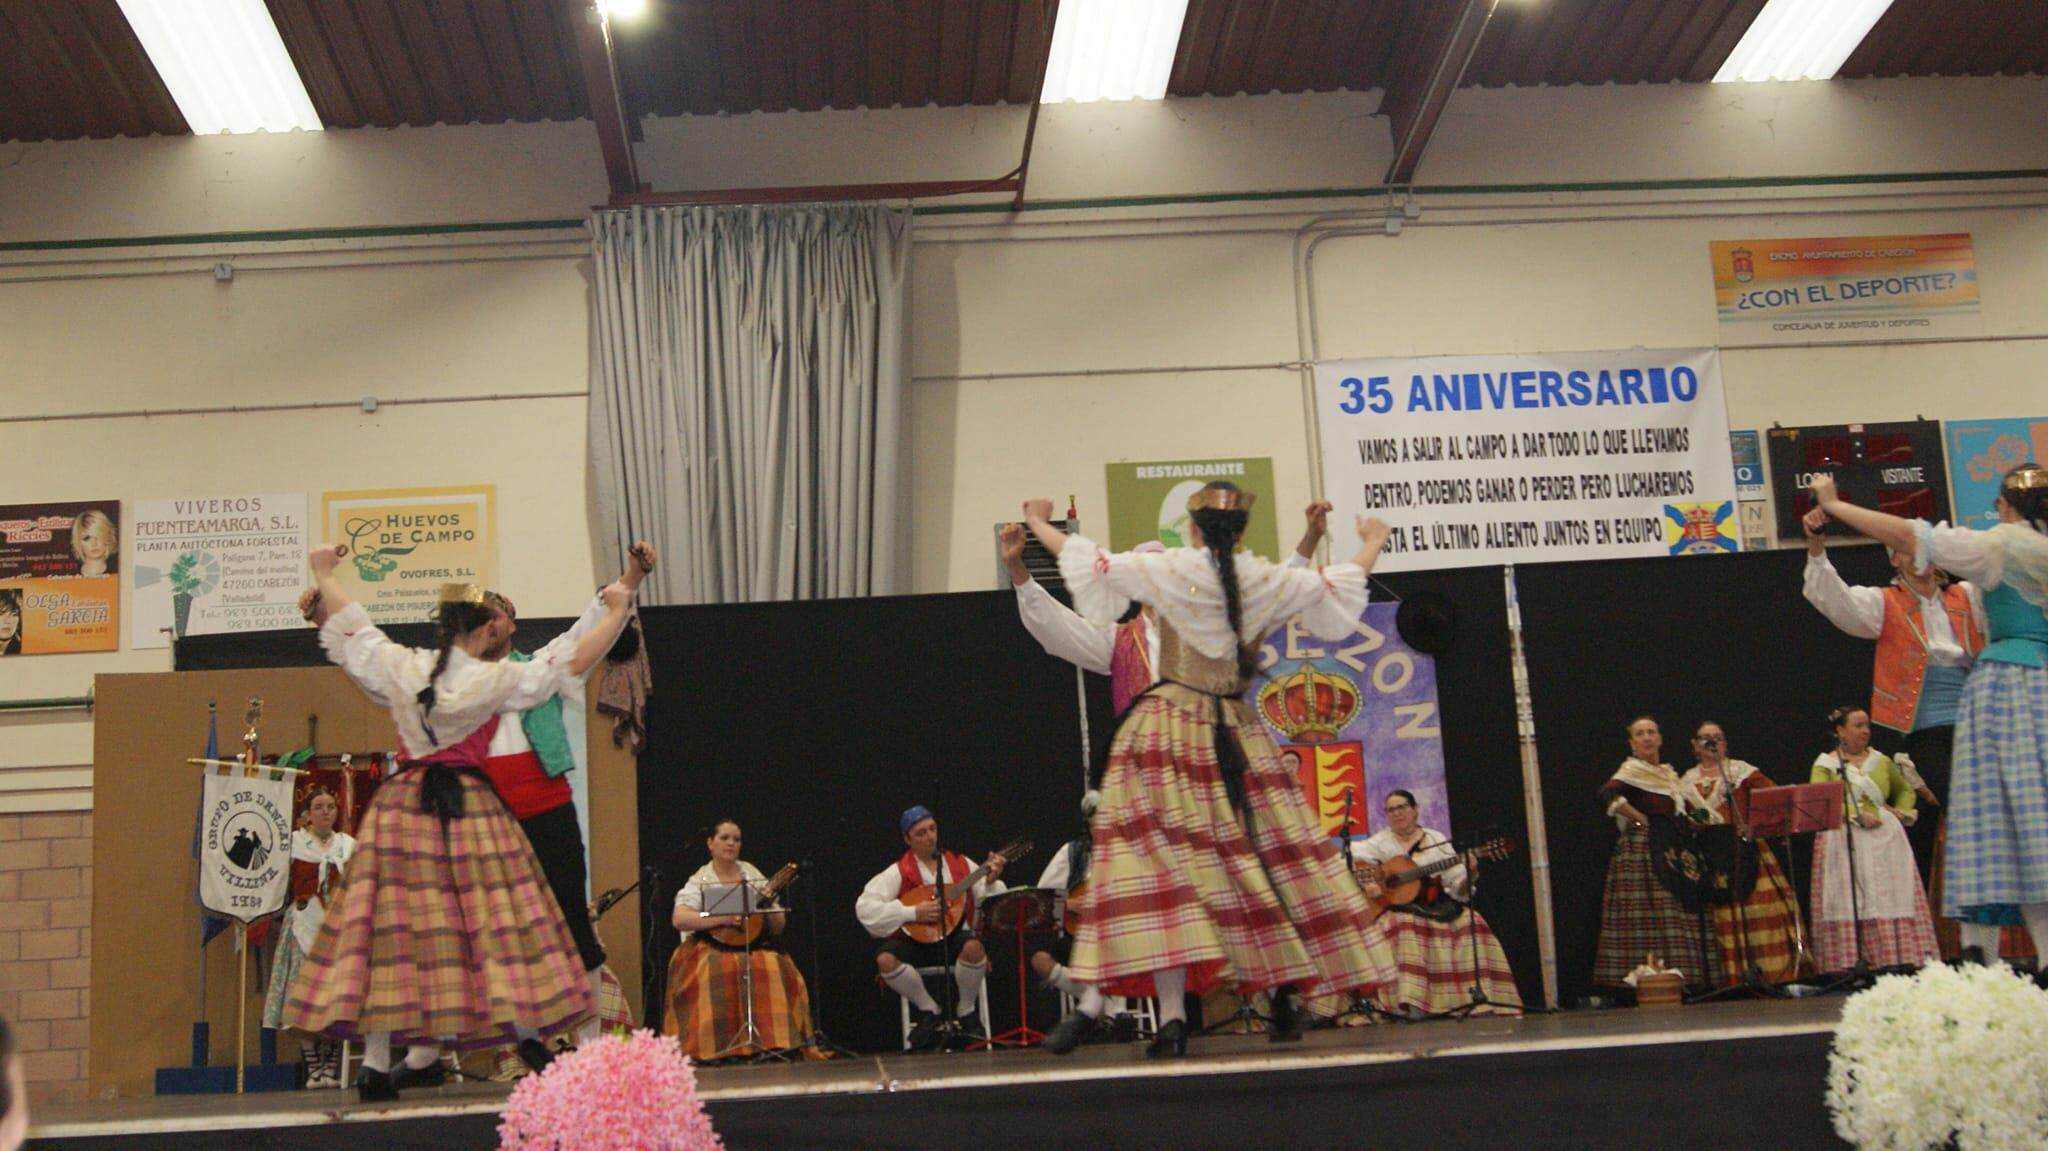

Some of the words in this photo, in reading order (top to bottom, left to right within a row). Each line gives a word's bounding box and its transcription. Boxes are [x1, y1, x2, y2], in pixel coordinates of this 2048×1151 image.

[1738, 288, 1800, 310] ¿CON
[1807, 285, 1834, 303] EL
[1840, 273, 1957, 300] DEPORTE?
[1340, 376, 1394, 415] 35
[1407, 366, 1698, 412] ANIVERSARIO
[1358, 438, 1398, 465] VAMOS
[1402, 437, 1410, 462] A
[1413, 436, 1444, 461] SALIR
[1448, 436, 1463, 461] AL
[1466, 433, 1507, 460] CAMPO
[1511, 433, 1520, 458] A
[1522, 432, 1547, 458] DAR
[1548, 431, 1579, 457] TODO
[1583, 429, 1599, 456] LO
[1603, 428, 1628, 455] QUE
[1631, 426, 1689, 454] LLEVAMOS
[1136, 462, 1246, 479] RESTAURANTE
[1881, 466, 1925, 484] VISITANTE
[1364, 481, 1417, 509] DENTRO,
[1417, 478, 1472, 505] PODEMOS
[1476, 477, 1516, 503] GANAR
[1519, 476, 1528, 500] O
[1532, 475, 1577, 501] PERDER
[1580, 473, 1612, 500] PERO
[1616, 470, 1694, 498] LUCHAREMOS
[174, 497, 262, 515] VIVEROS
[136, 516, 265, 536] FUENTEAMARGA,
[270, 515, 299, 530] S.L.
[386, 514, 460, 527] HUEVOS
[137, 542, 177, 552] PLANTA
[247, 536, 299, 546] FORESTAL
[380, 532, 403, 545] DE
[410, 529, 475, 543] CAMPO
[1379, 526, 1408, 553] STA
[1412, 525, 1428, 550] EL
[1432, 521, 1479, 549] ÚLTIMO
[1486, 521, 1538, 548] ALIENTO
[1544, 520, 1589, 546] JUNTOS
[1595, 519, 1611, 544] EN
[1615, 517, 1662, 544] EQUIPO
[400, 569, 453, 578] OVOFRES,
[456, 568, 475, 577] S.L.
[26, 592, 71, 611] OLGA
[232, 791, 253, 804] DE
[256, 793, 290, 852] DANZAS
